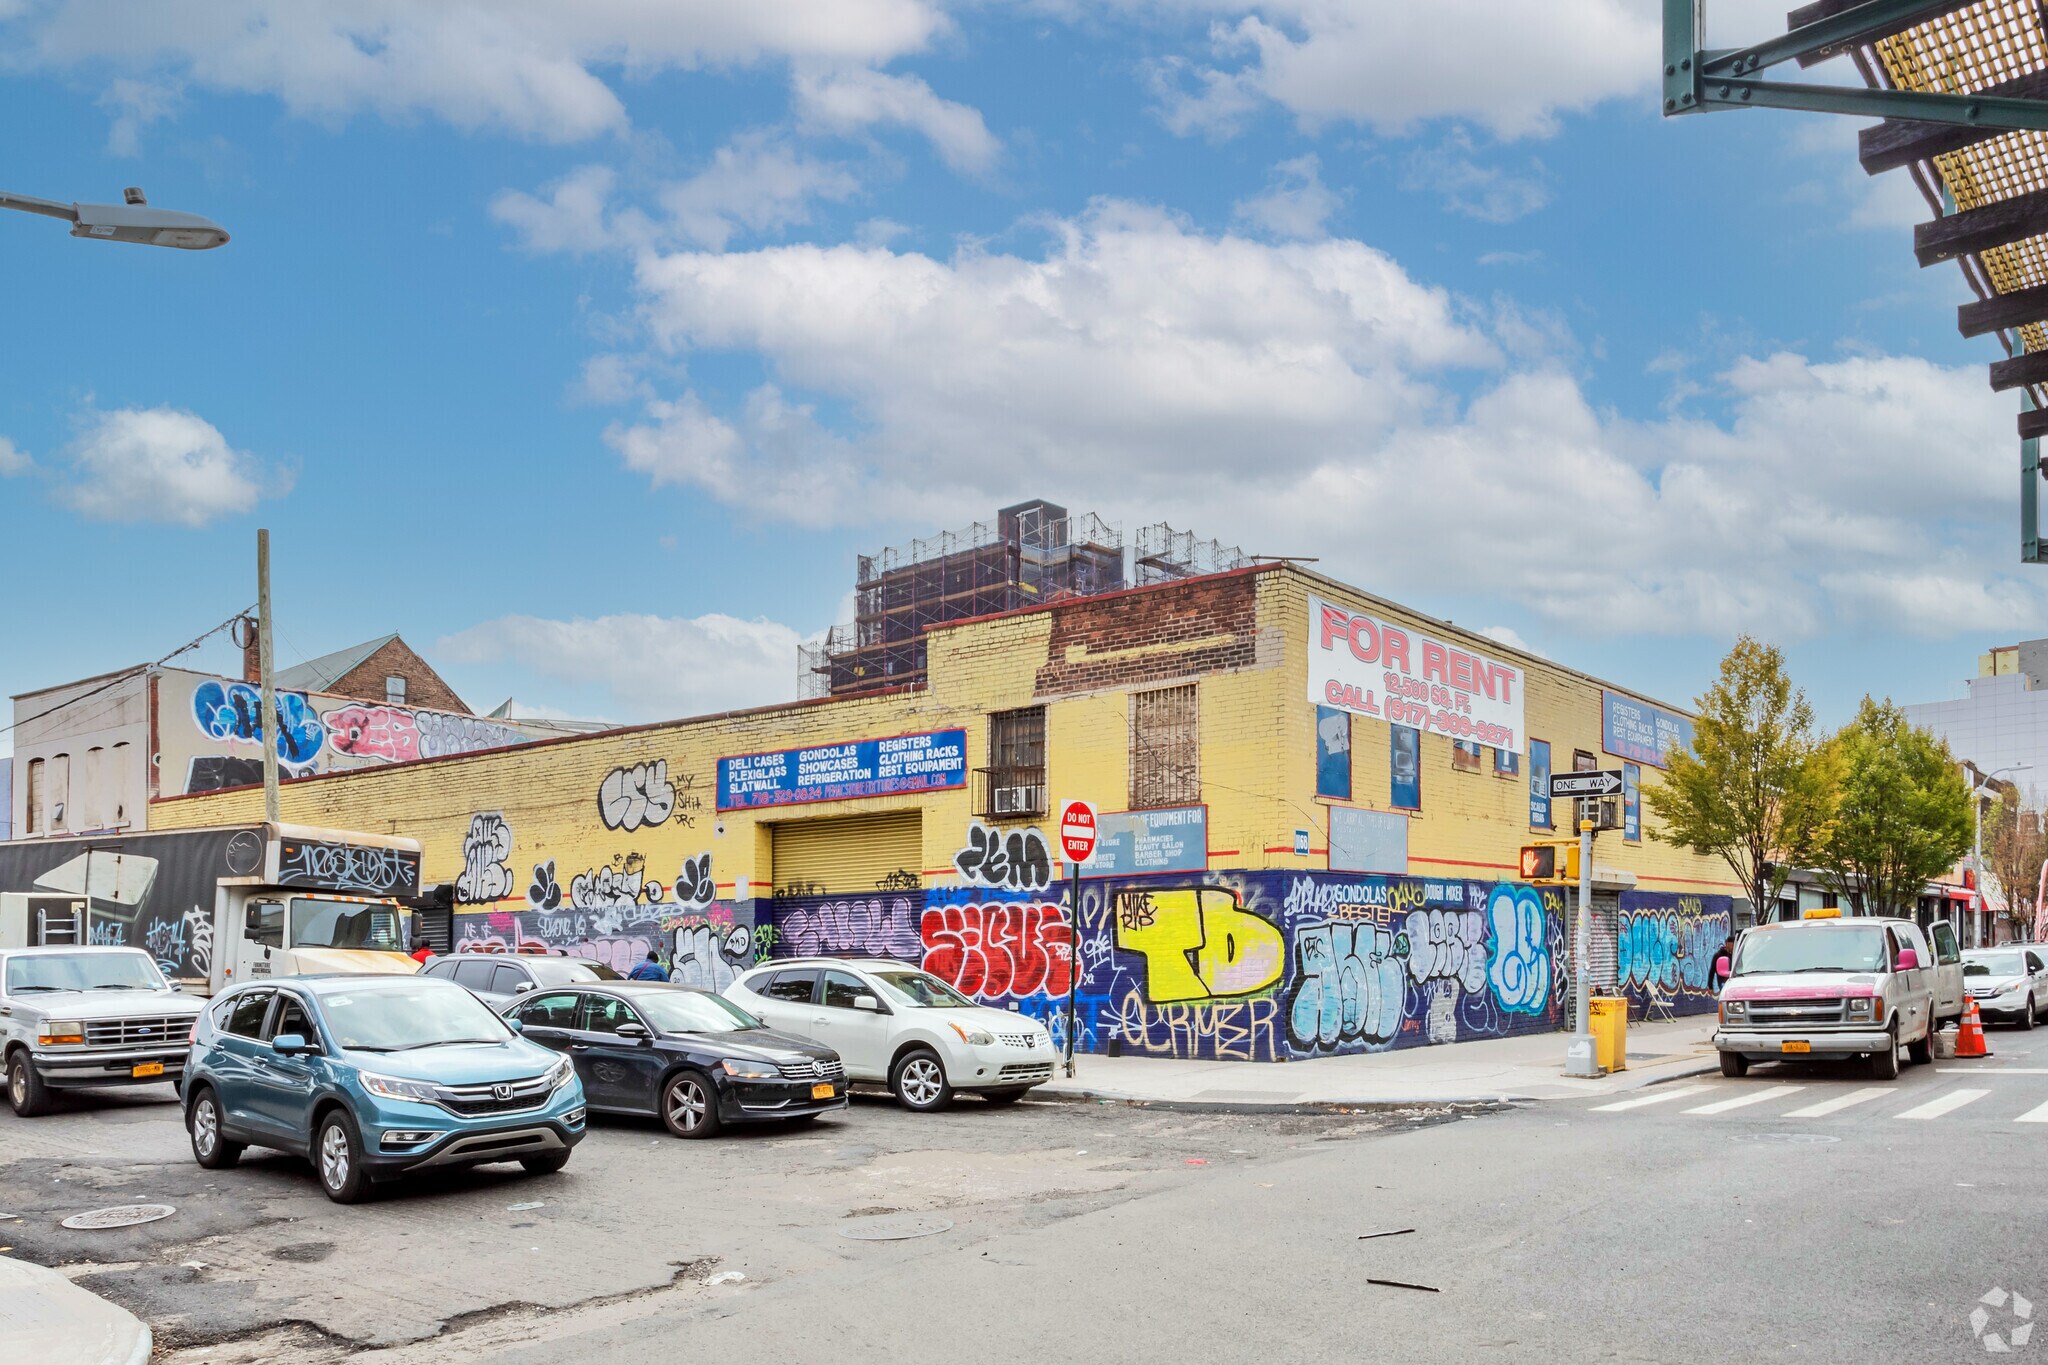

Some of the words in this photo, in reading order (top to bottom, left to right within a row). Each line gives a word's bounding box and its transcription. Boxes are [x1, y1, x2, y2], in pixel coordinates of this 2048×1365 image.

[1321, 603, 1411, 674] FOR
[1422, 639, 1516, 704] RENT
[1383, 672, 1429, 701] 12,500
[1455, 692, 1472, 714] FT.
[1325, 679, 1380, 715] CALL
[1384, 696, 1514, 749] (917)-309-9271
[879, 736, 932, 753] REGISTERS
[798, 745, 857, 762] GONDOLAS
[879, 750, 924, 765] CLOTHING
[926, 746, 959, 760] RACKS
[729, 757, 751, 771] DELI
[754, 754, 785, 768] CASES
[798, 757, 858, 774] SHOWCASES
[878, 764, 903, 778] REST.
[905, 758, 963, 774] EQUIPAMENT
[729, 766, 787, 782] PLEXIGLASS
[798, 768, 872, 786] REFRIGERATION
[729, 779, 781, 794] SLATWALL
[1555, 780, 1577, 790] ONE
[1589, 778, 1612, 788] WAY
[752, 786, 822, 805] 718-329-0824
[1067, 812, 1077, 822] DO
[1078, 813, 1091, 824] NOT
[1150, 810, 1187, 828] EQUIPMENT
[1187, 807, 1202, 824] FOR
[1067, 839, 1089, 851] ENTER
[1135, 834, 1174, 844] PHARMACIES
[1135, 843, 1160, 851] BEAUTY
[1162, 841, 1184, 849] SALON
[1135, 850, 1162, 859] BARBER
[1165, 848, 1182, 858] SHOP
[1135, 857, 1169, 867] CLOTHING
[1335, 883, 1387, 904] GONDOLAS
[1424, 883, 1444, 901] DOUGH
[1446, 885, 1464, 902] MIXER
[1120, 892, 1158, 916] MIKE
